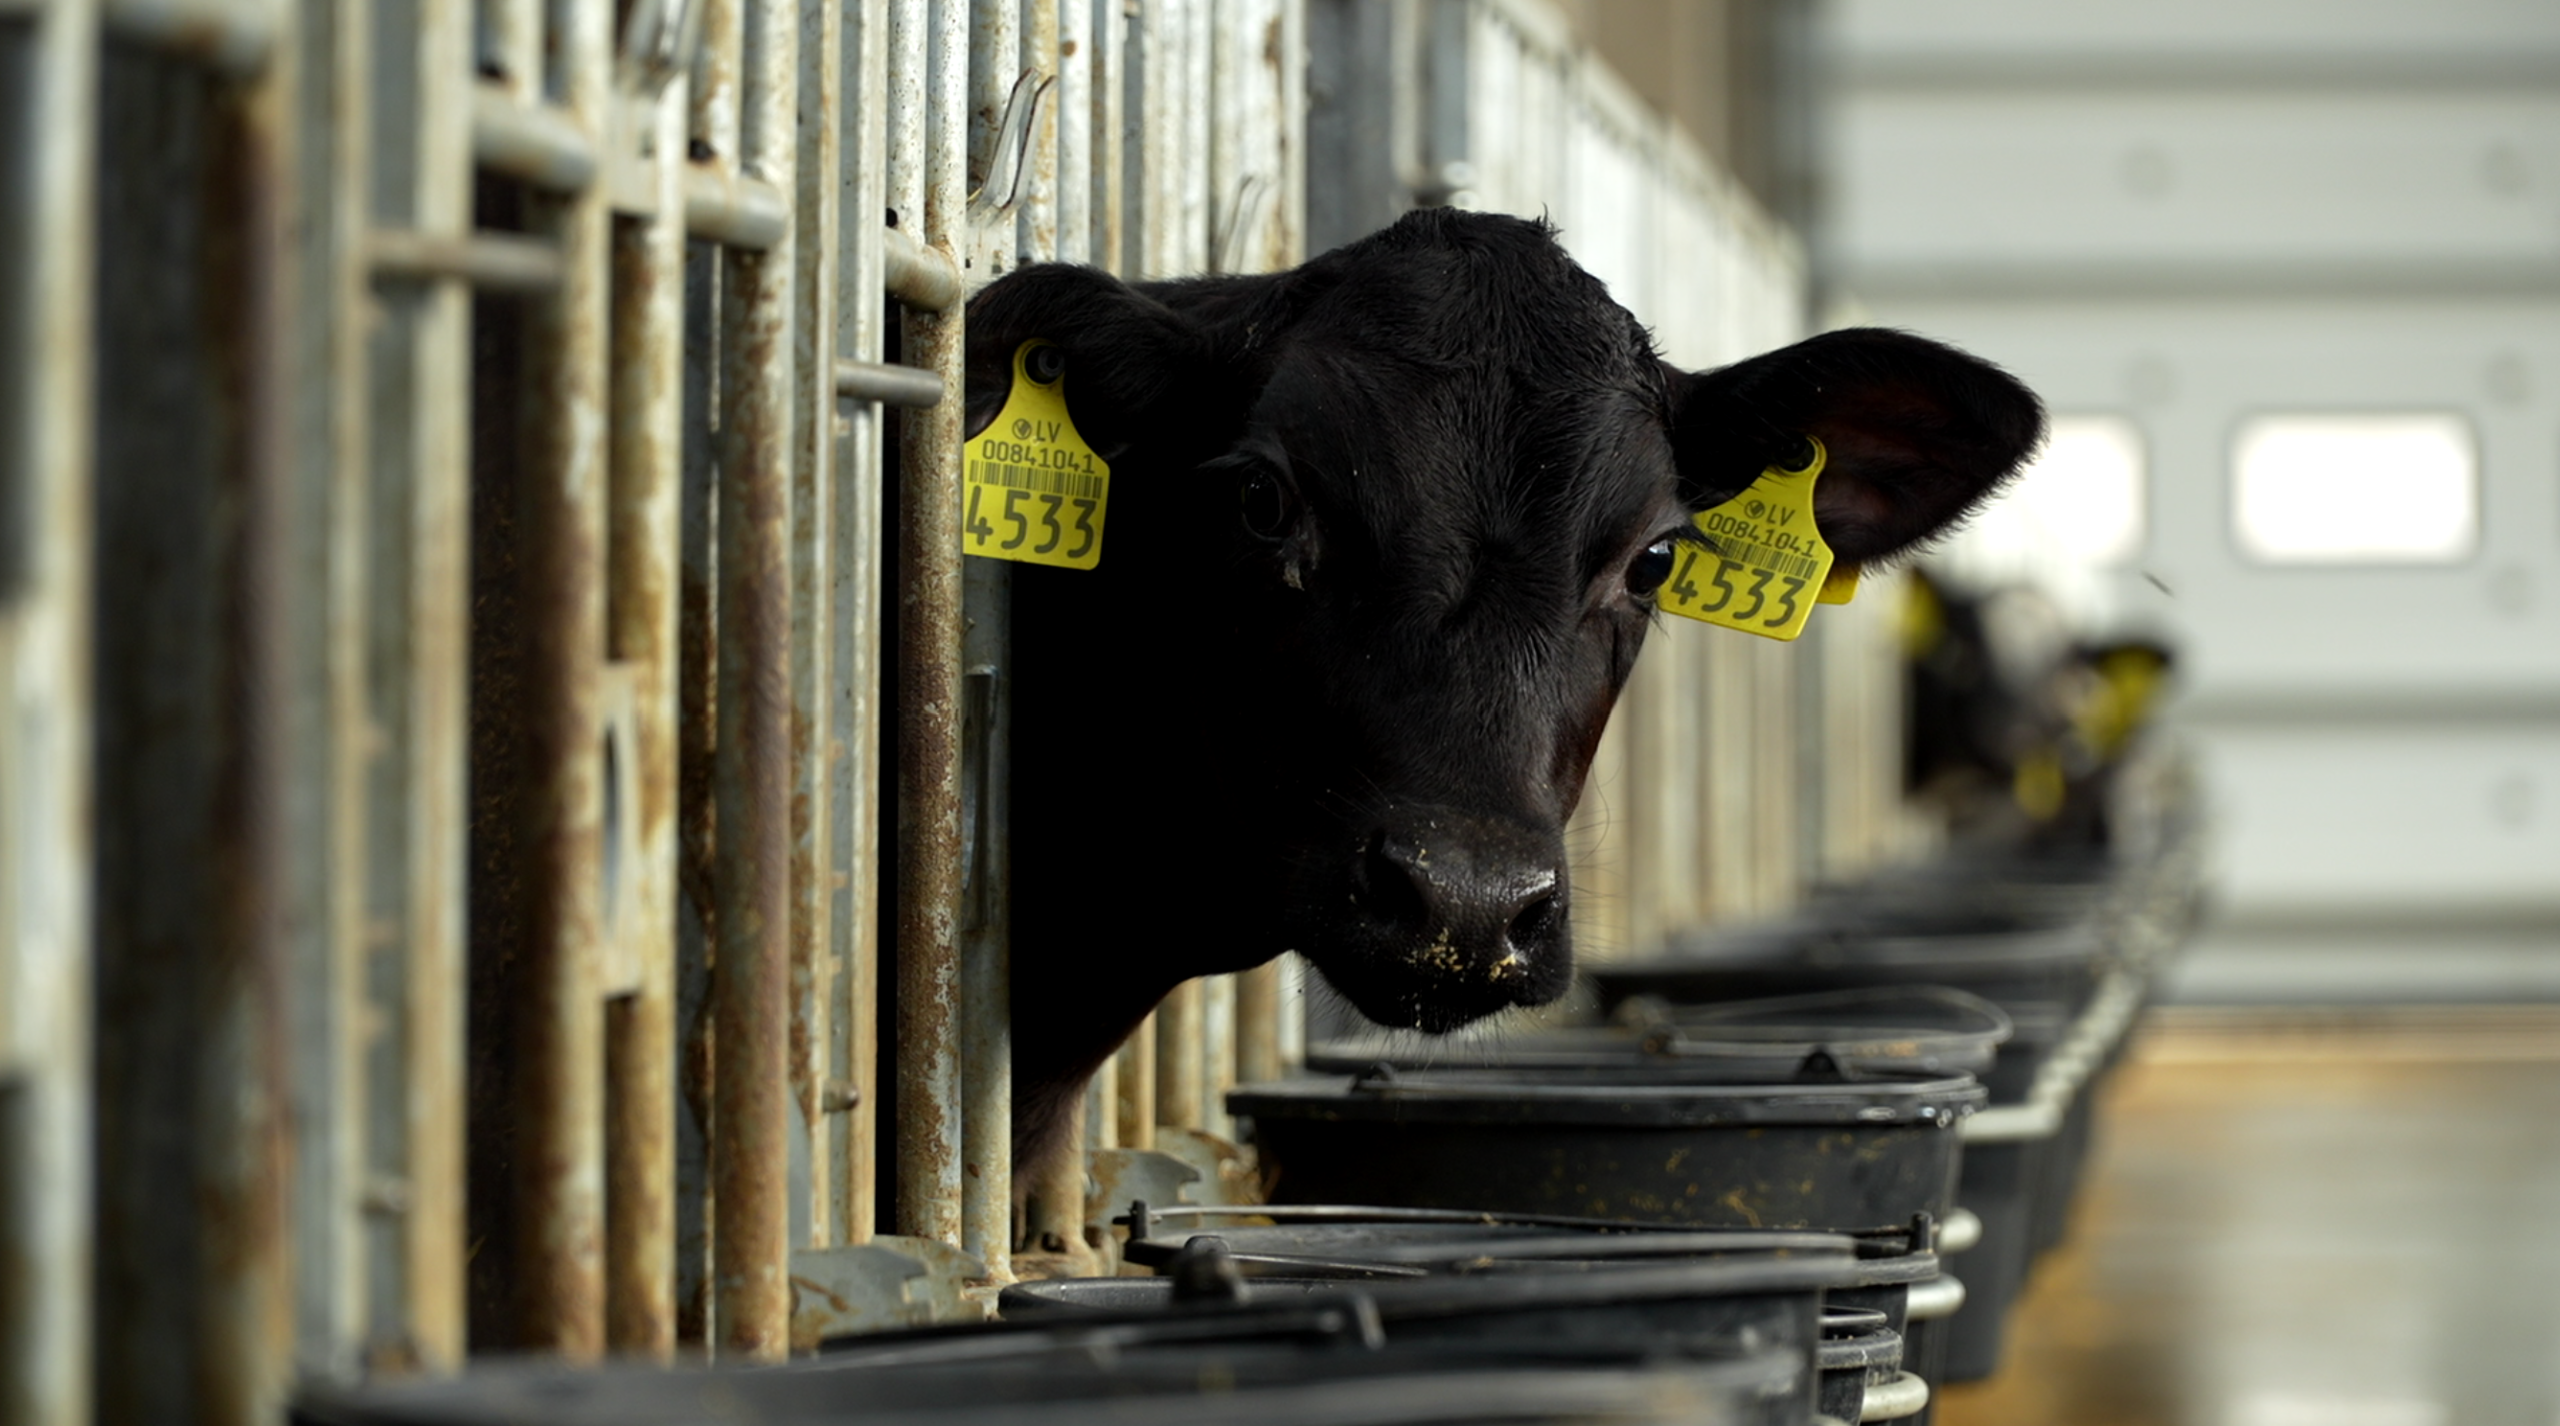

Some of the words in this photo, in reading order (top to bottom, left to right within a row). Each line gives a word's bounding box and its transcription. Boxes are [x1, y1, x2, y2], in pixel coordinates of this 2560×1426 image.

[1036, 420, 1062, 443] LV
[982, 439, 1096, 474] 00841041
[965, 485, 1098, 559] 4533
[1706, 513, 1817, 558] 00841041
[1766, 504, 1796, 527] LV
[1670, 551, 1807, 628] 4533
